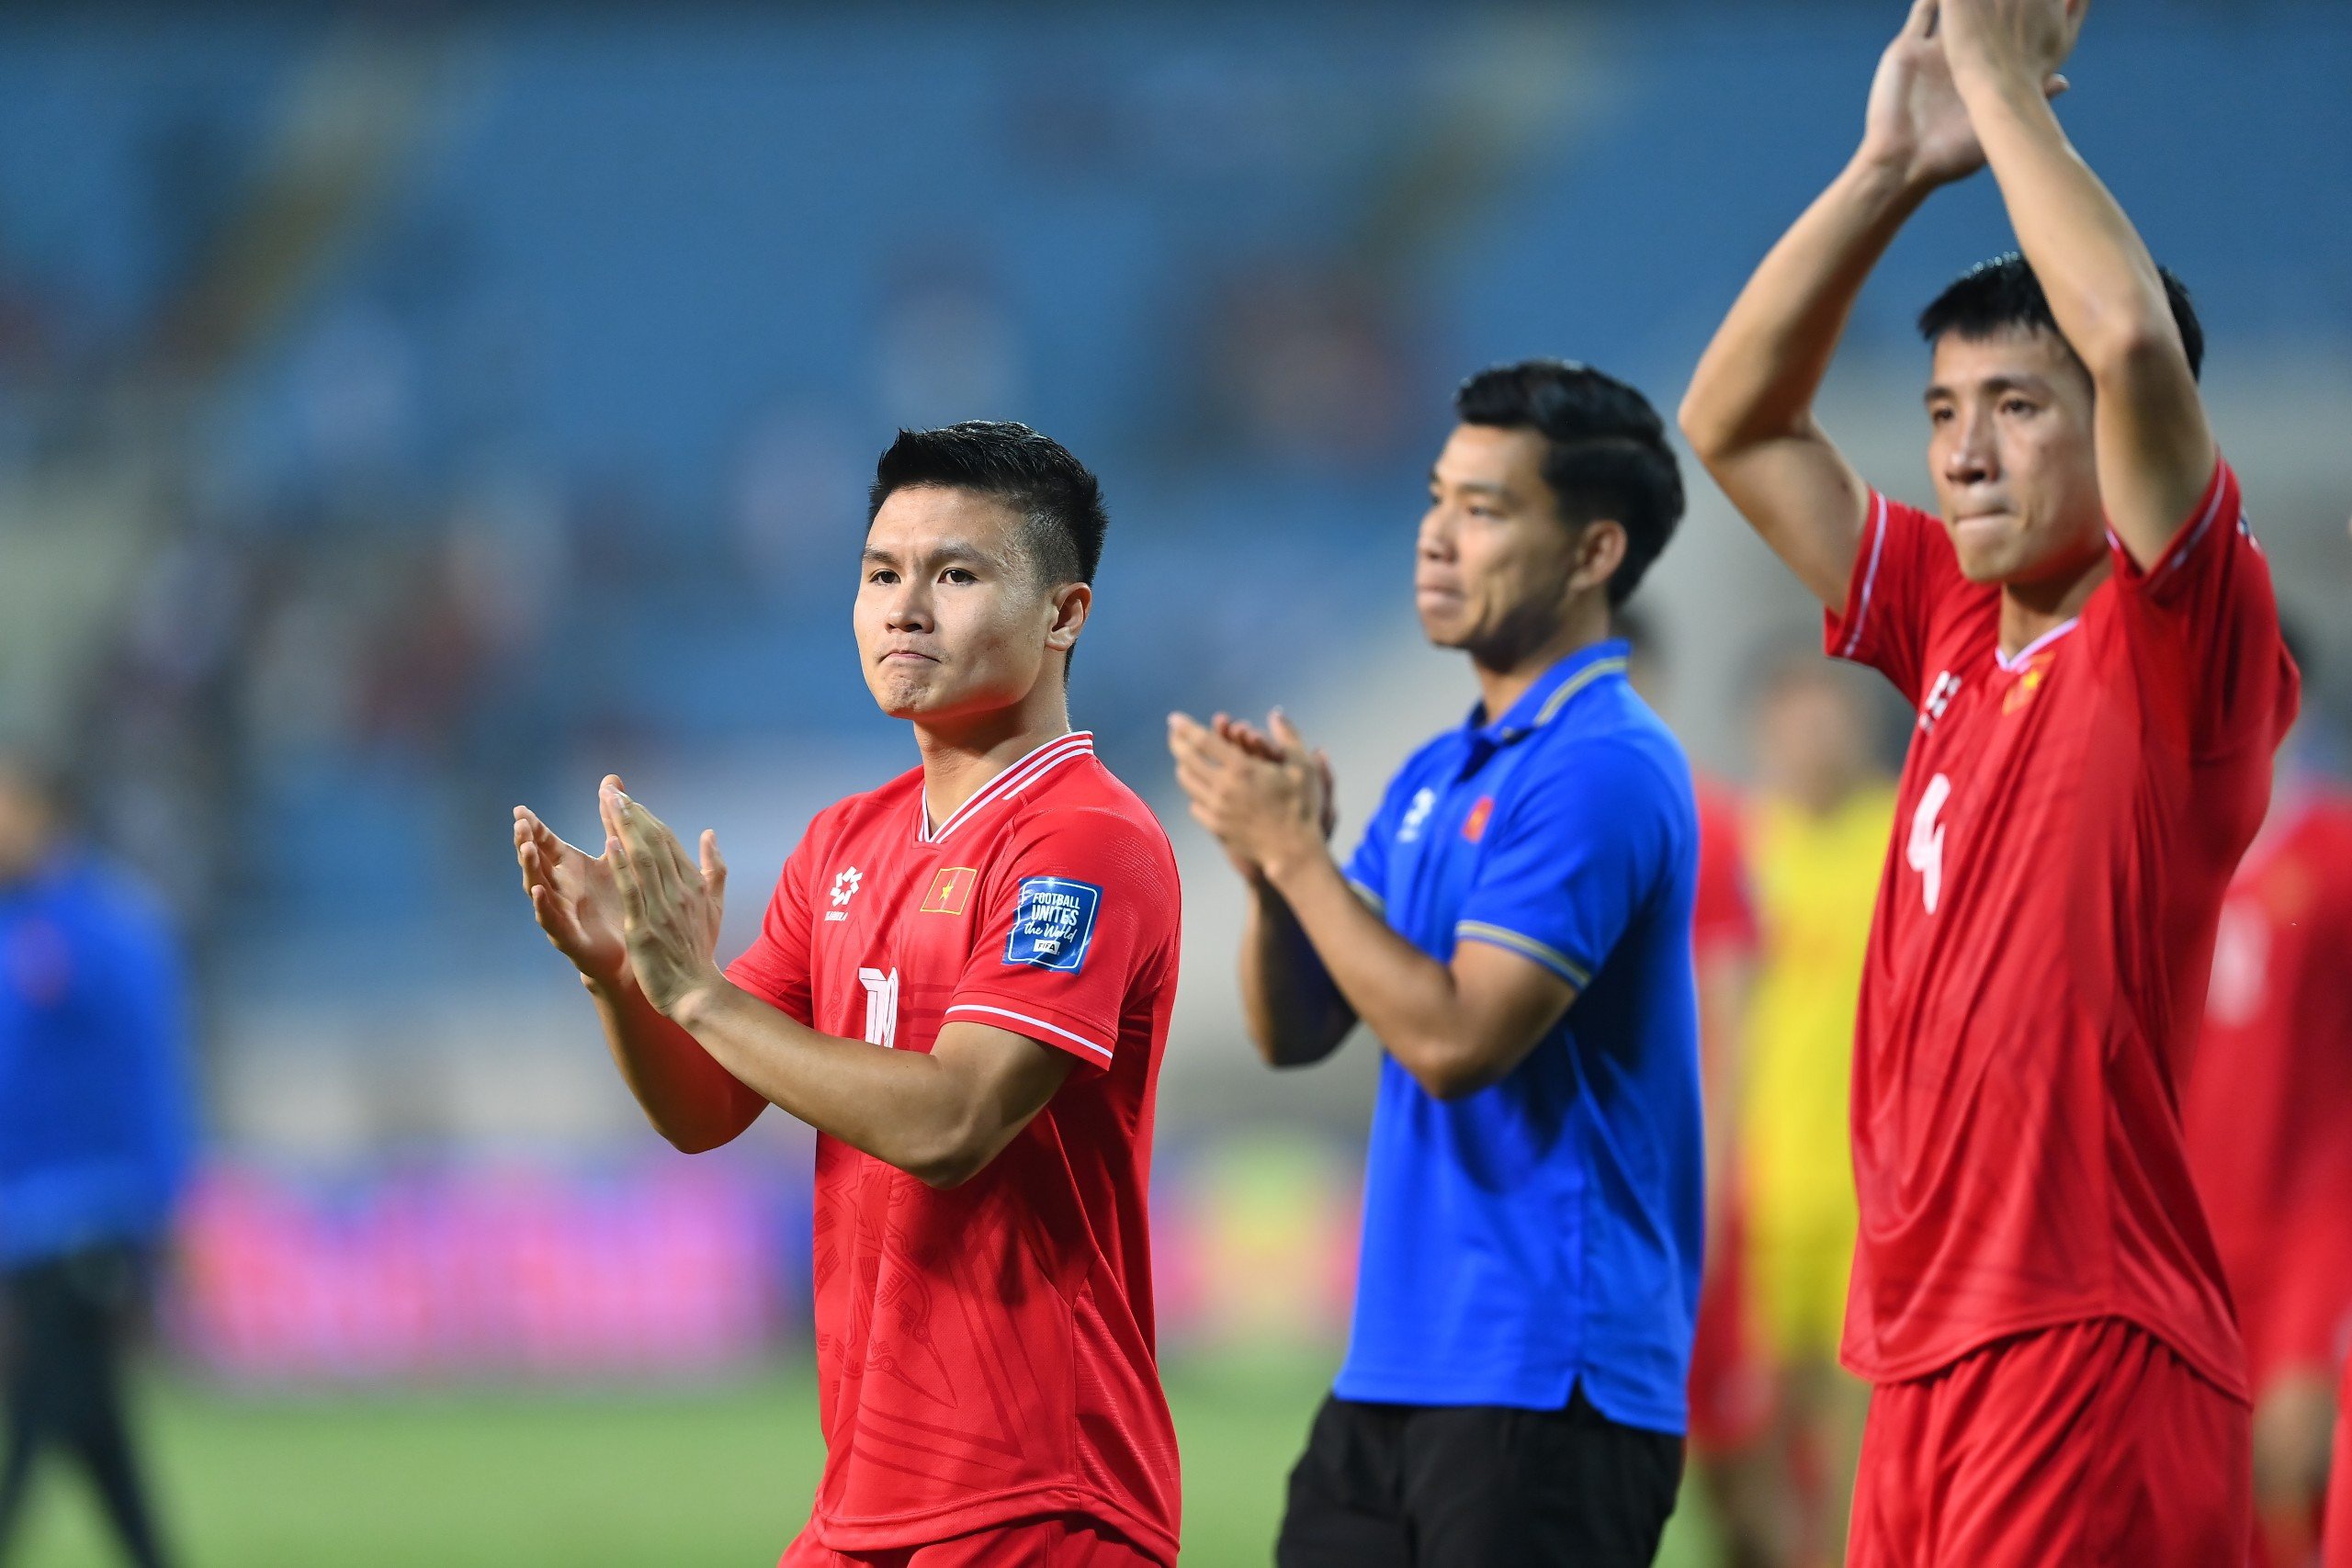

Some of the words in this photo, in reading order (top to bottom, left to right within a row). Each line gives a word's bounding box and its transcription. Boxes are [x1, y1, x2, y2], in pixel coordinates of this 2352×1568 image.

[1906, 773, 1951, 915] 4
[1032, 892, 1080, 909] FOOTBALL
[1031, 905, 1080, 927] UNITES
[1024, 920, 1043, 935] the
[1044, 923, 1078, 943] World
[1037, 942, 1056, 952] FIFA
